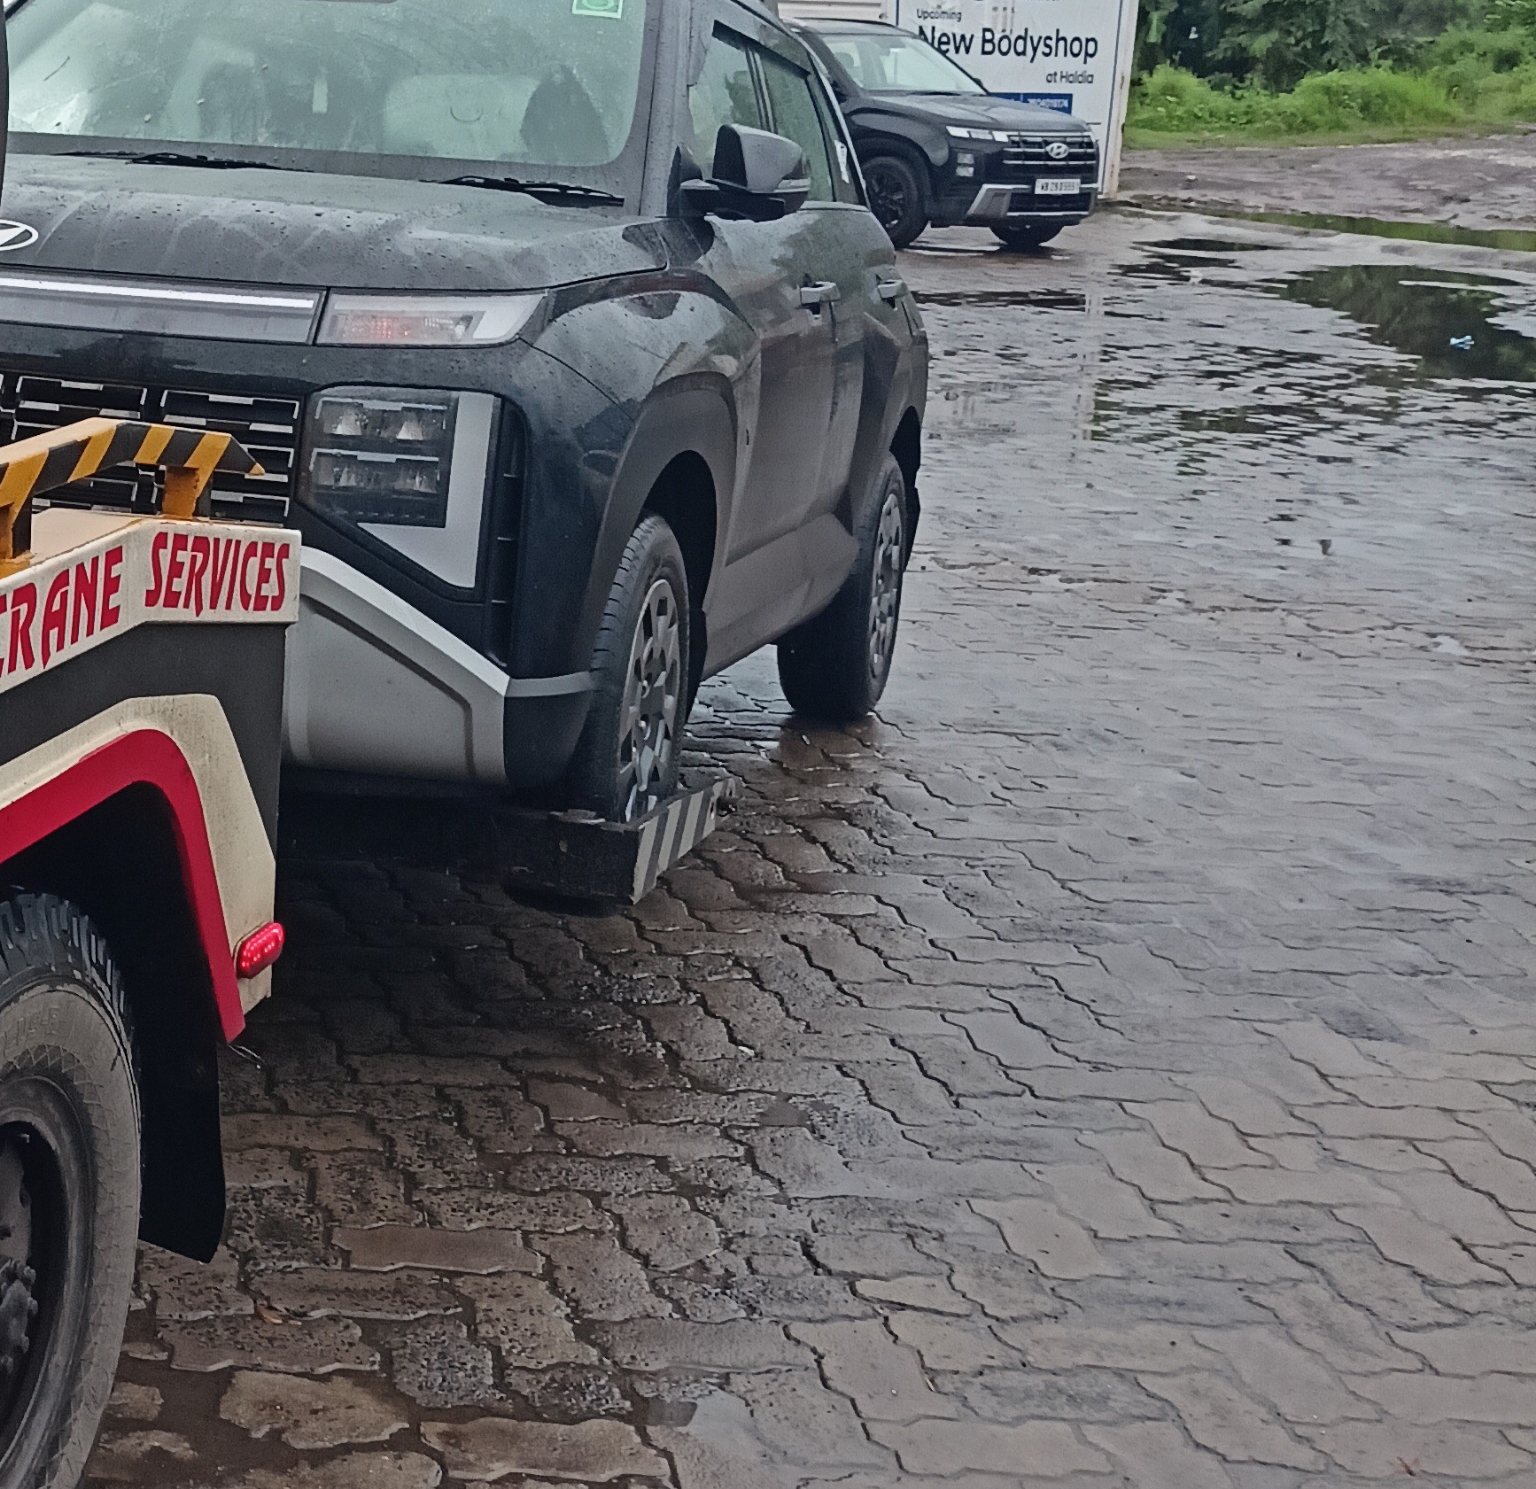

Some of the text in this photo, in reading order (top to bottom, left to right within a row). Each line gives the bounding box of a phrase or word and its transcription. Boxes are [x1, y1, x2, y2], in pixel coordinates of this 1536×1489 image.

[916, 8, 962, 22] Upcoming
[980, 27, 1099, 65] Bodyshop
[1045, 70, 1095, 85] at Haldia
[144, 530, 291, 617] SERVICES
